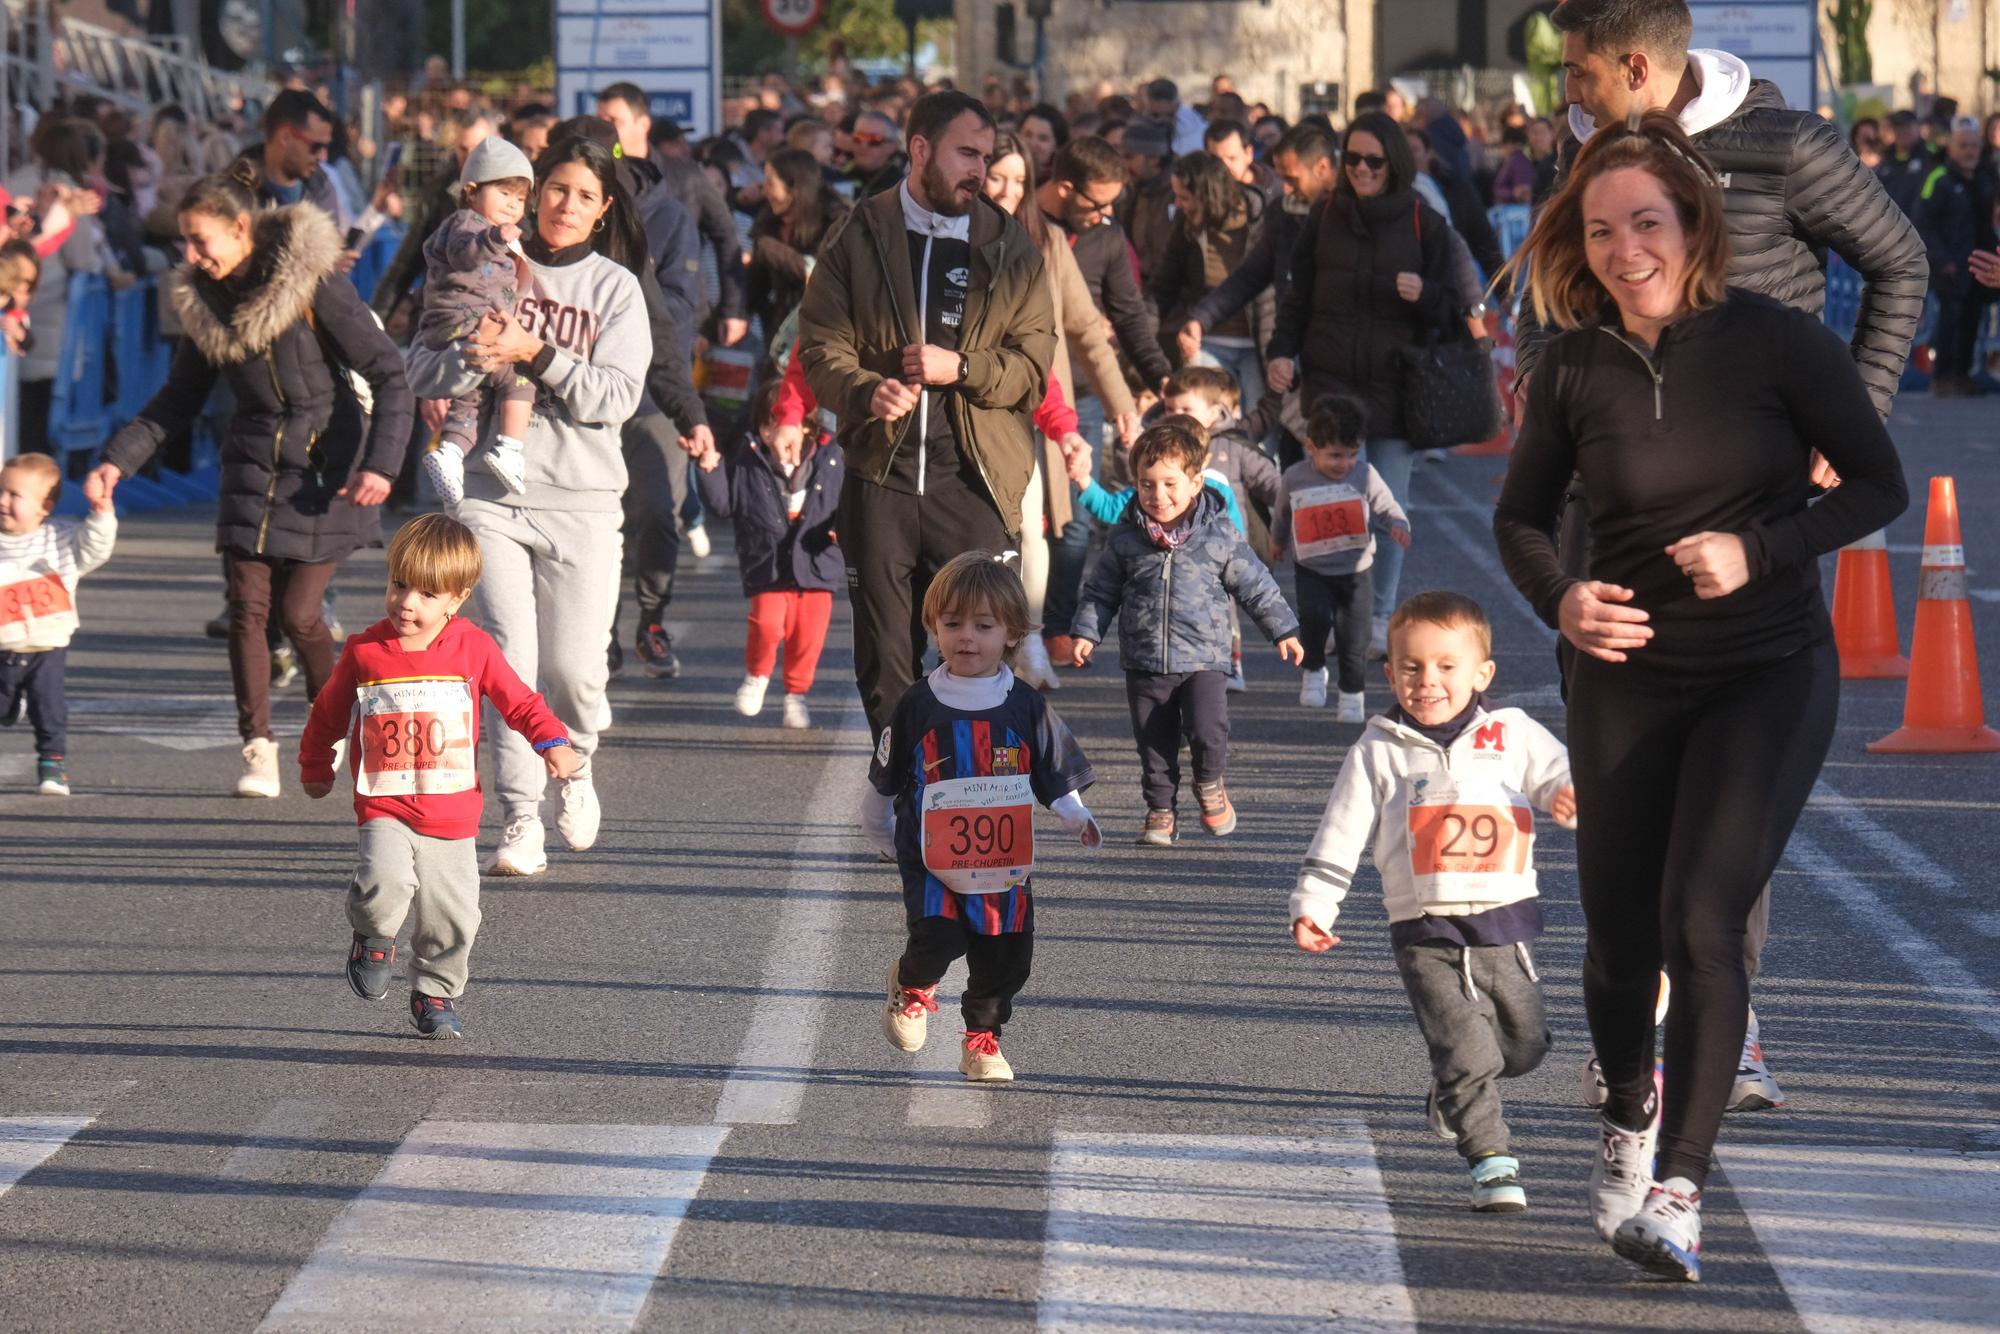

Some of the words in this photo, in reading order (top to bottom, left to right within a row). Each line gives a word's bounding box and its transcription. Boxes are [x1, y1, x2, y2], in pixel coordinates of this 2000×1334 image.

[513, 297, 600, 363] STON
[5, 581, 53, 614] 343
[382, 718, 446, 758] 380
[1473, 721, 1505, 752] M
[964, 783, 987, 795] MINI
[949, 813, 1014, 856] 390
[1440, 814, 1499, 858] 29
